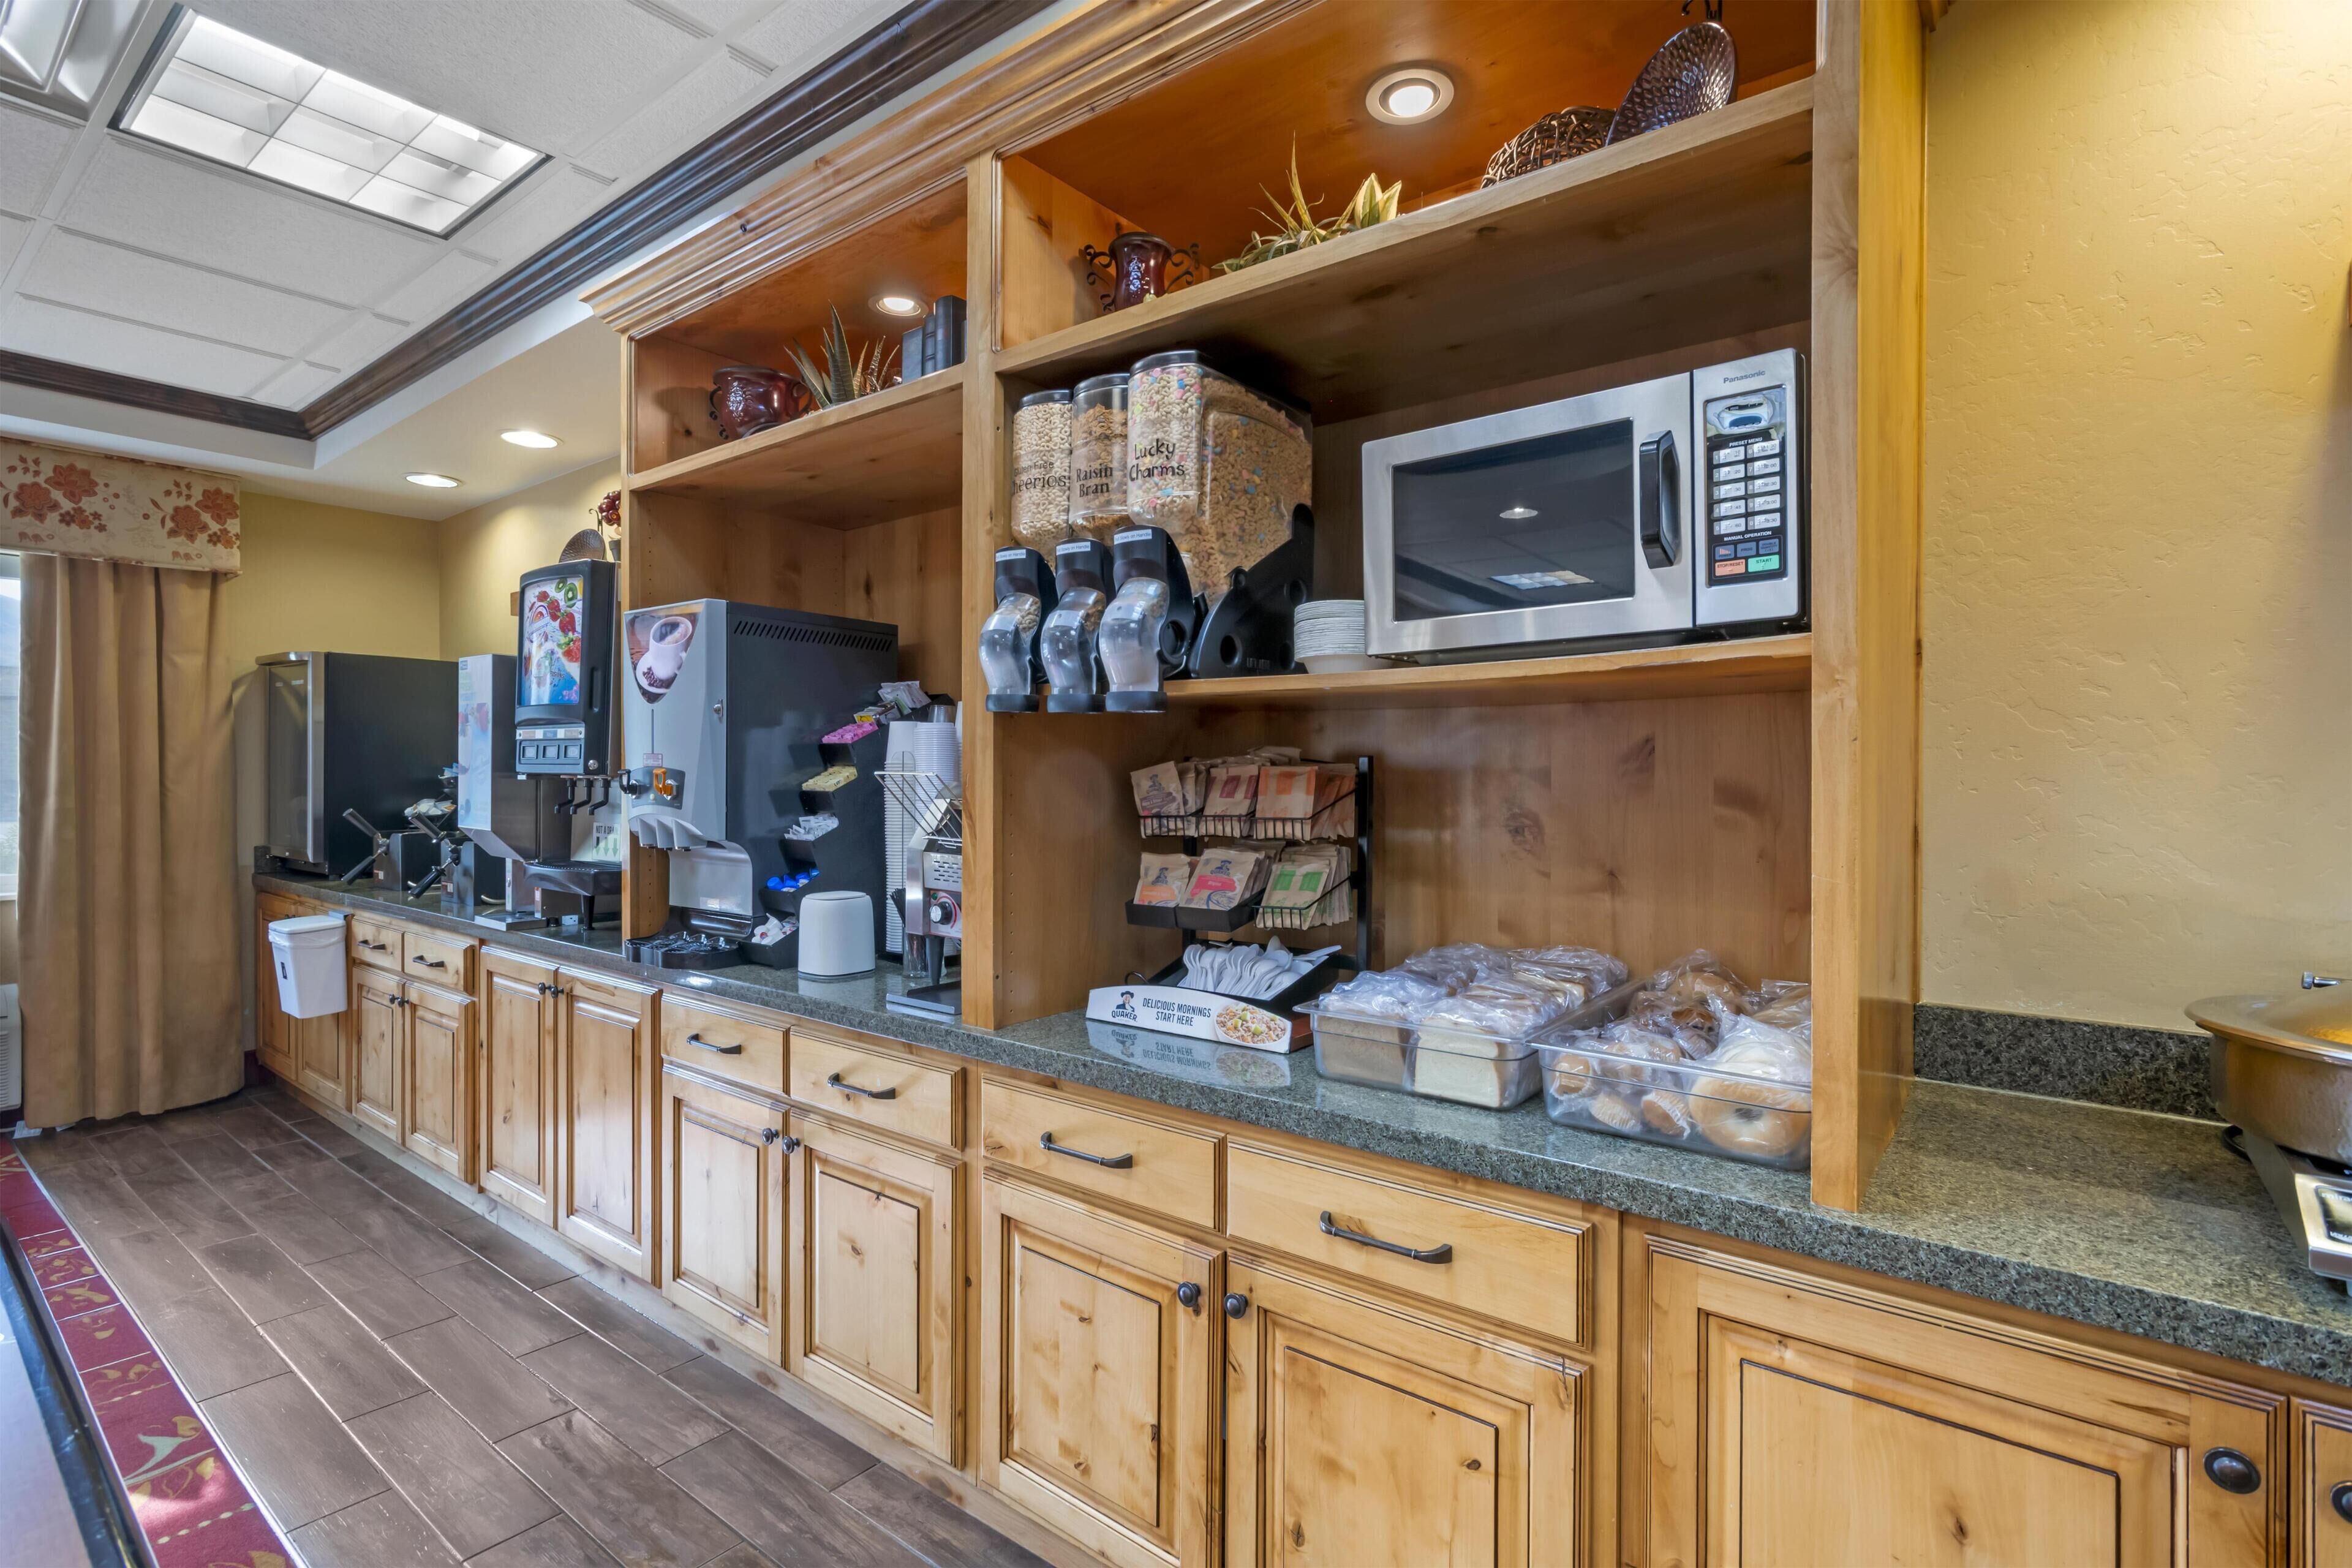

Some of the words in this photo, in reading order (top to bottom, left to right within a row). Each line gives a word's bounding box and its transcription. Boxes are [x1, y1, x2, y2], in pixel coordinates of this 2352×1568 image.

[1723, 370, 1766, 383] Panasonic
[1134, 438, 1176, 460] Lucky
[1034, 461, 1054, 470] Free
[1076, 463, 1114, 483] Raisin
[1129, 463, 1185, 482] Charms
[1011, 473, 1067, 496] heerios
[1079, 481, 1110, 498] Bran
[1111, 1009, 1138, 1022] QUAKER
[1142, 997, 1176, 1012] DELICIOUS
[1177, 1003, 1212, 1018] MORNINGS
[1155, 1011, 1176, 1023] START
[1176, 1015, 1194, 1027] HERE
